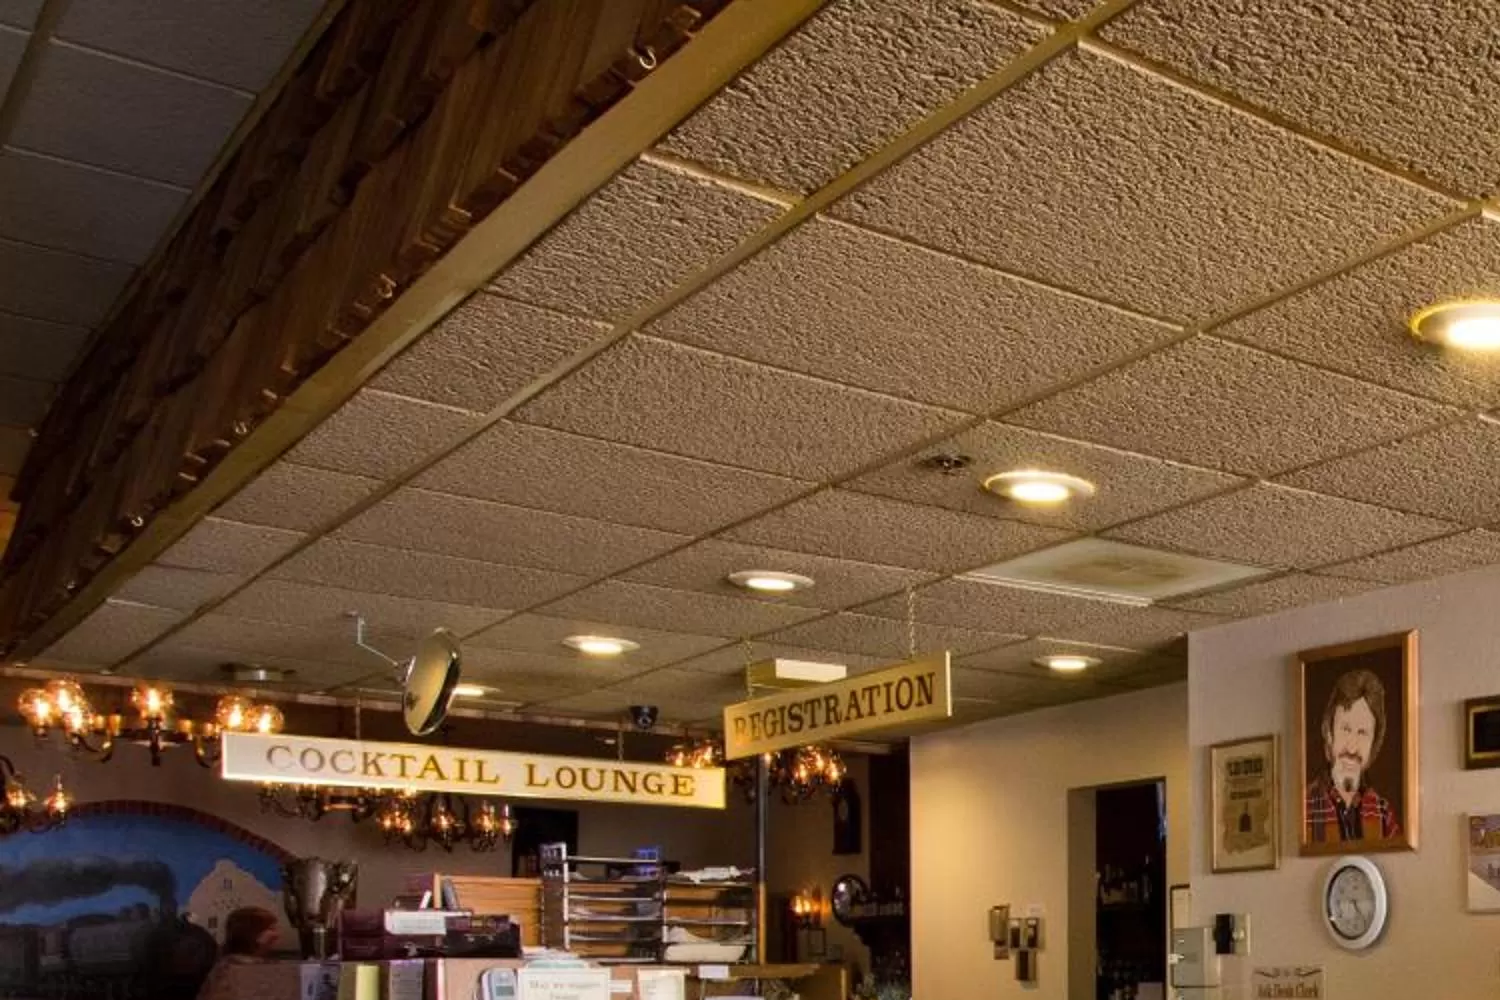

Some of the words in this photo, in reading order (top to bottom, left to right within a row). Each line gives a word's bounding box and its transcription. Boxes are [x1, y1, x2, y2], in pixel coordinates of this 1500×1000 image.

[733, 672, 936, 742] REGISTRATION
[265, 744, 499, 784] COCKTAIL
[525, 762, 696, 797] LOUNGE
